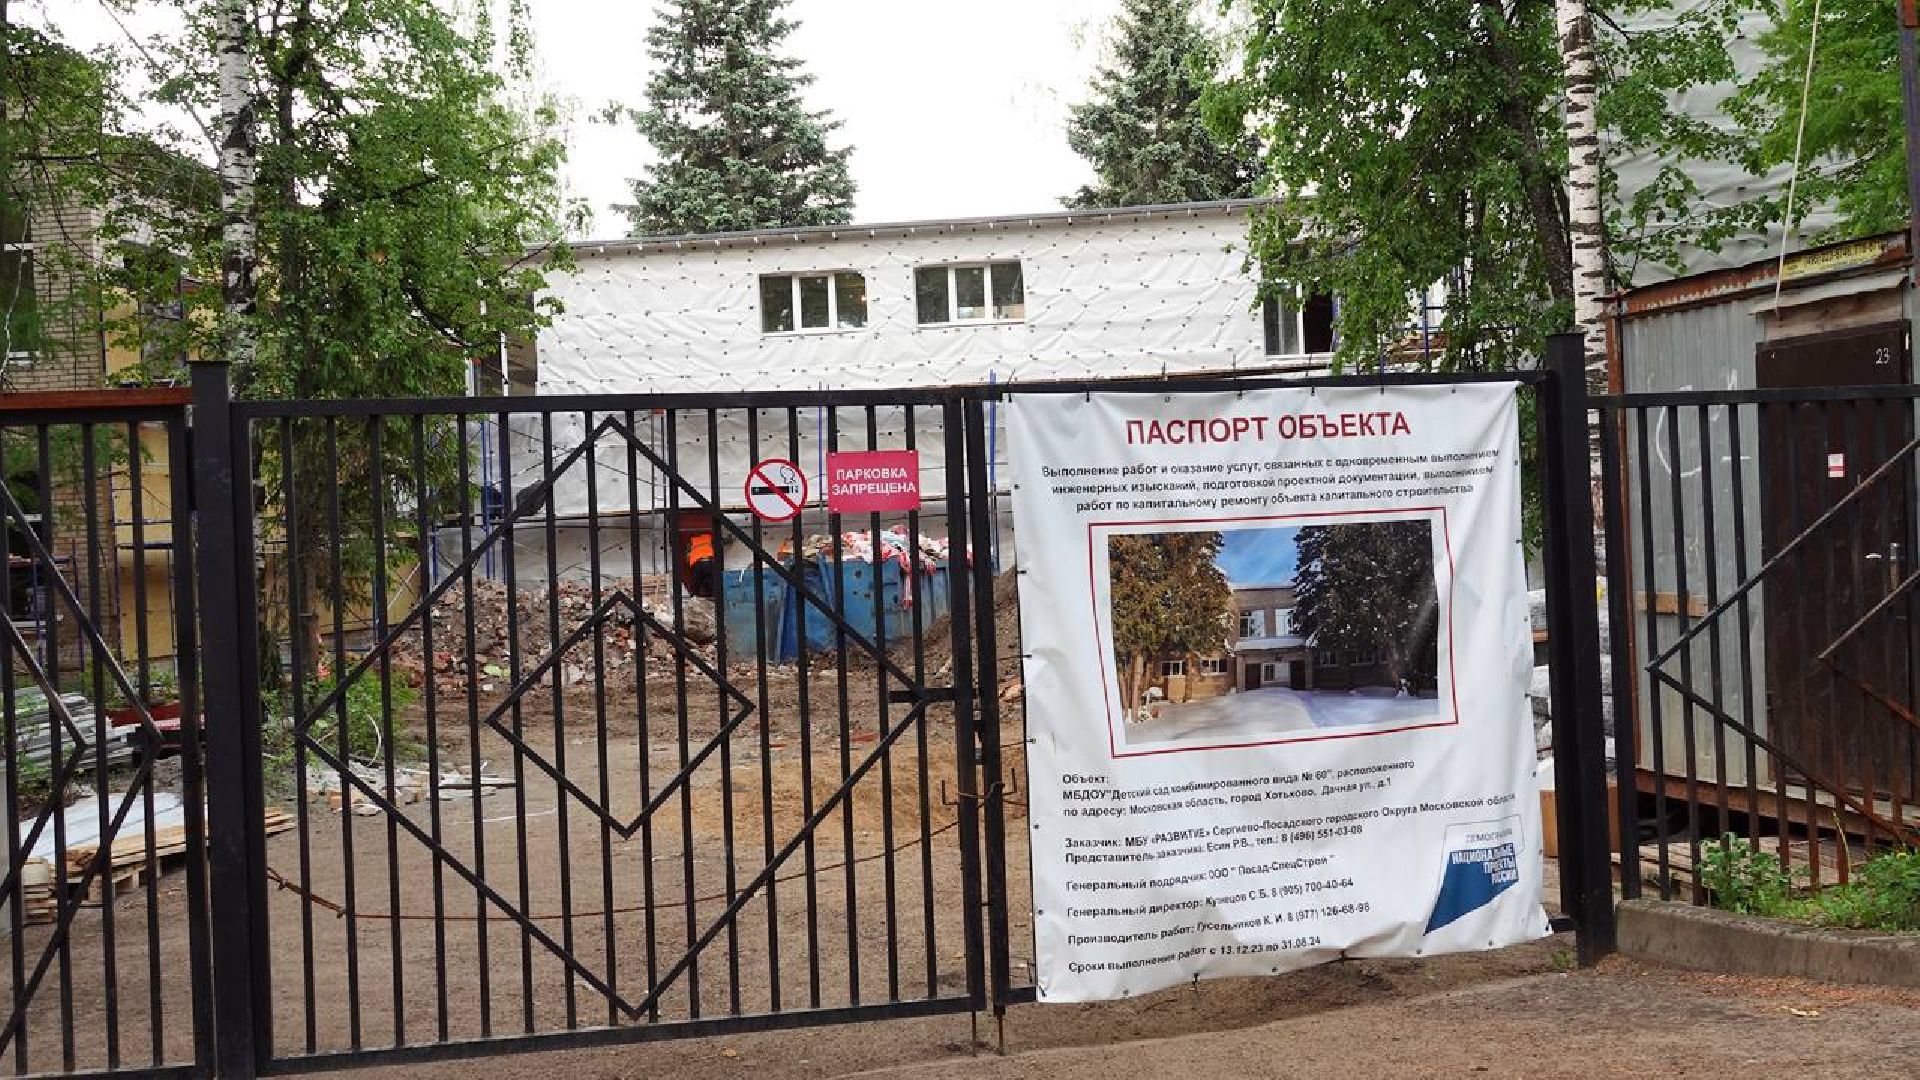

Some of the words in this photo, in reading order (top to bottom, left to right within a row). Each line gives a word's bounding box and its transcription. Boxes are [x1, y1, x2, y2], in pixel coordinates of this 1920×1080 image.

[1876, 347, 1890, 364] 23
[1126, 416, 1268, 445] ПАСПОРТ
[1279, 412, 1411, 440] ОБЪЕКТА
[836, 468, 908, 481] ПАРКОВКА
[1042, 464, 1119, 477] Выполнение
[1122, 463, 1157, 476] работ
[1161, 465, 1168, 474] и
[1170, 463, 1223, 474] оказание
[1227, 462, 1261, 475] услуг,
[1263, 458, 1323, 470] связанных
[1326, 458, 1333, 467] с
[1335, 454, 1428, 469] одновременным
[1431, 450, 1499, 463] выполнением
[832, 482, 917, 496] ЗАПРЕЩЕНА
[1053, 482, 1128, 495] инженерных
[1132, 480, 1199, 493] изысканий,
[1203, 477, 1275, 492] подготовкой
[1277, 474, 1335, 488] проектной
[1338, 470, 1420, 485] документации,
[1423, 466, 1493, 480] выполнением
[1077, 500, 1111, 513] работ
[1116, 501, 1129, 510] по
[1133, 499, 1216, 511] капитальному
[1221, 496, 1268, 509] ремонту
[1271, 492, 1317, 505] объекта
[1319, 488, 1393, 502] капитального
[1395, 484, 1473, 498] строительства
[1062, 774, 1109, 784] Объект:
[1153, 786, 1170, 797] сад
[1171, 777, 1270, 794] комбинированного
[1272, 774, 1299, 784] вида
[1302, 772, 1313, 781] №
[1337, 760, 1415, 778] расположенного
[1064, 807, 1078, 817] по
[1081, 805, 1126, 818] адресу:
[1130, 801, 1183, 815] Московская
[1185, 796, 1228, 809] область,
[1230, 792, 1262, 804] город
[1264, 788, 1317, 800] Хотьково,
[1321, 783, 1357, 796] Дачная
[1065, 837, 1121, 848] Заказчик:
[1125, 836, 1148, 847] МБУ
[1213, 818, 1323, 835] Сергиево-Посадского
[1325, 809, 1379, 824] городского
[1382, 804, 1417, 818] Округа
[1419, 799, 1484, 812] Московской
[1065, 851, 1154, 864] Представитель
[1206, 842, 1230, 852] Есин
[1290, 830, 1315, 844] (496)
[1317, 824, 1363, 839] 551-03-08
[1066, 879, 1147, 892] Генеральный
[1149, 872, 1206, 887] подрядчик:
[1208, 867, 1229, 879] ООО
[1067, 906, 1147, 918] Генеральный
[1149, 899, 1202, 914] директор:
[1279, 884, 1303, 898] (905)
[1305, 877, 1354, 893] 700-40-64
[1068, 932, 1158, 946] Производитель
[1160, 925, 1195, 939] работ:
[1296, 908, 1318, 922] (977)
[1068, 962, 1105, 973] Сроки
[1107, 953, 1174, 970] выполнения
[1178, 946, 1206, 960] работ
[1210, 946, 1216, 955] с
[1221, 945, 1262, 954] 13.12.23
[1266, 943, 1279, 952] по
[1281, 936, 1321, 950] 31.08.24
